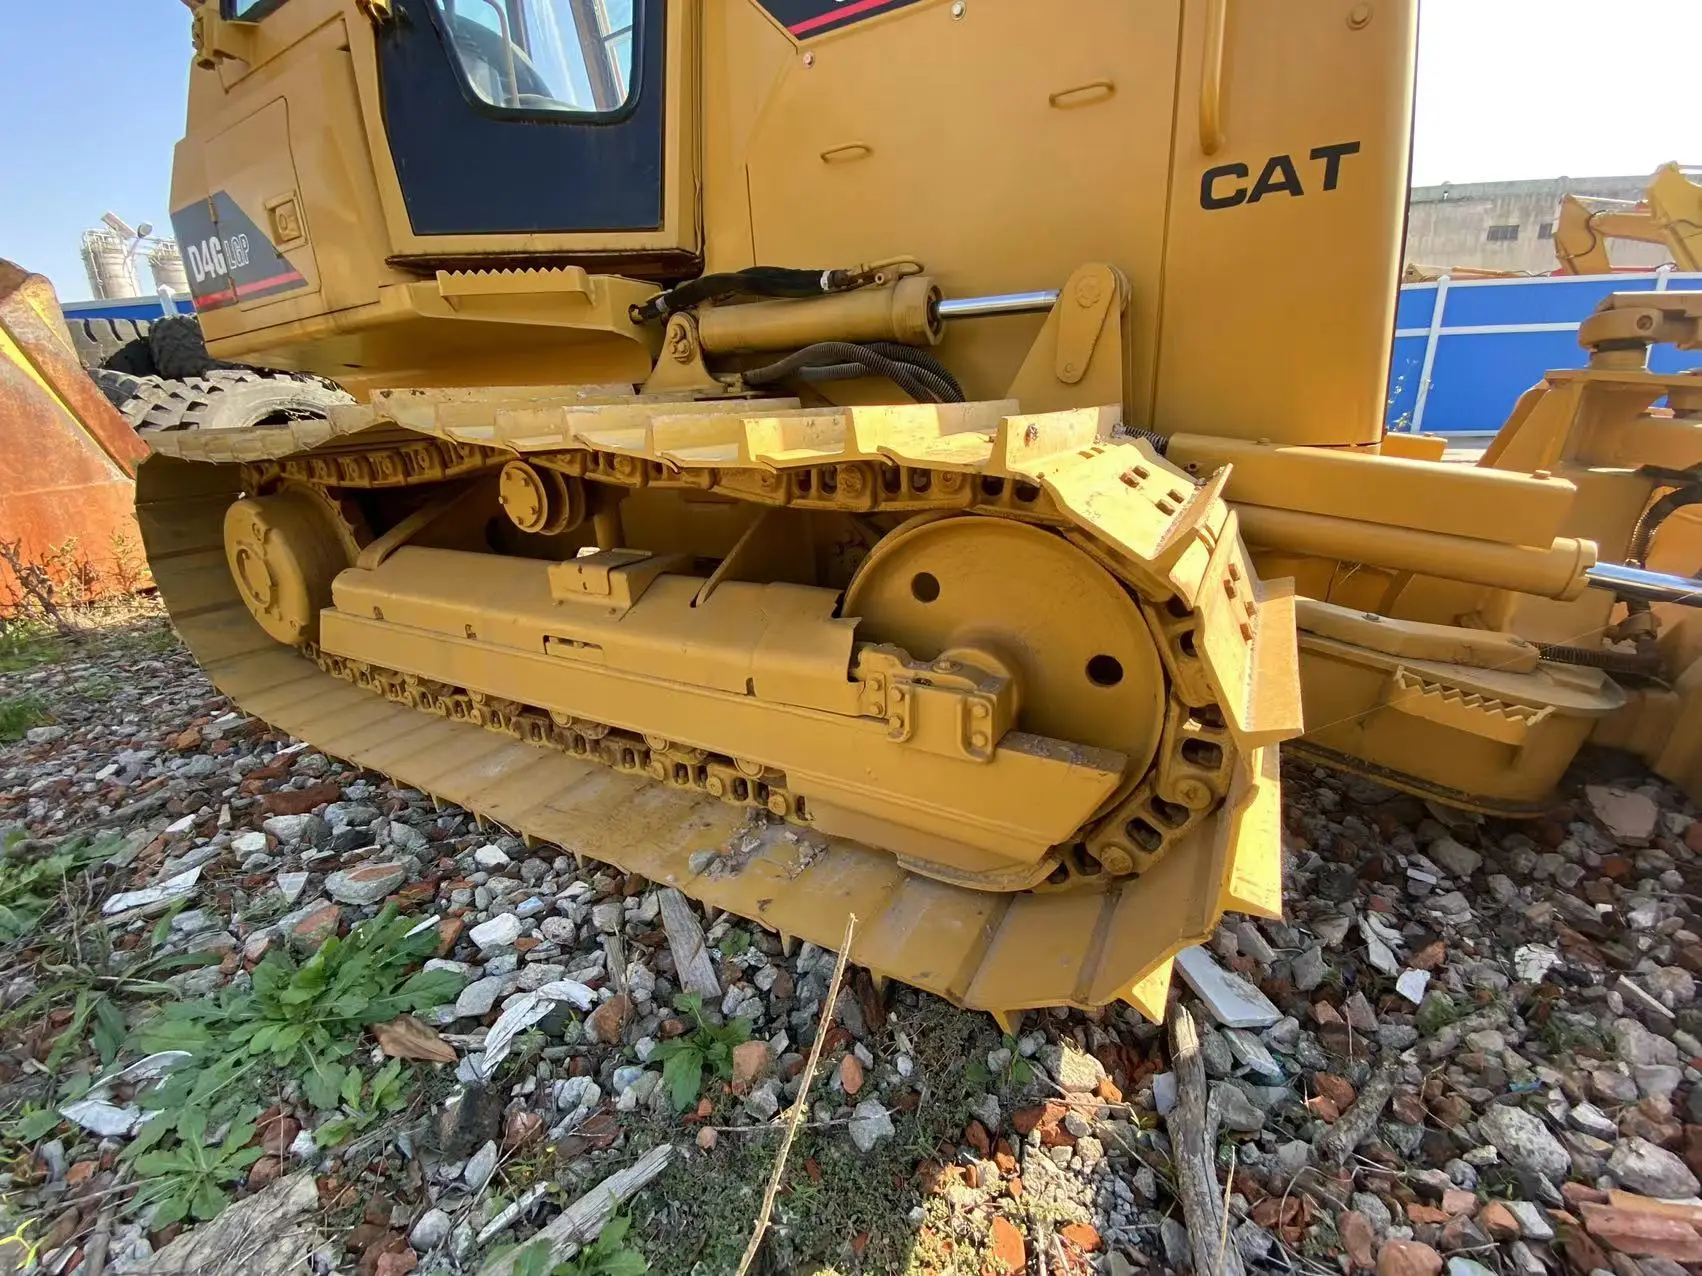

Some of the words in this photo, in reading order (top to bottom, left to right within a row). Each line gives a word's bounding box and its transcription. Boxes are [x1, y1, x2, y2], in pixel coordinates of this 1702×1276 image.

[1200, 141, 1360, 210] CAT
[187, 236, 228, 282] D4G
[223, 233, 250, 270] LGP
